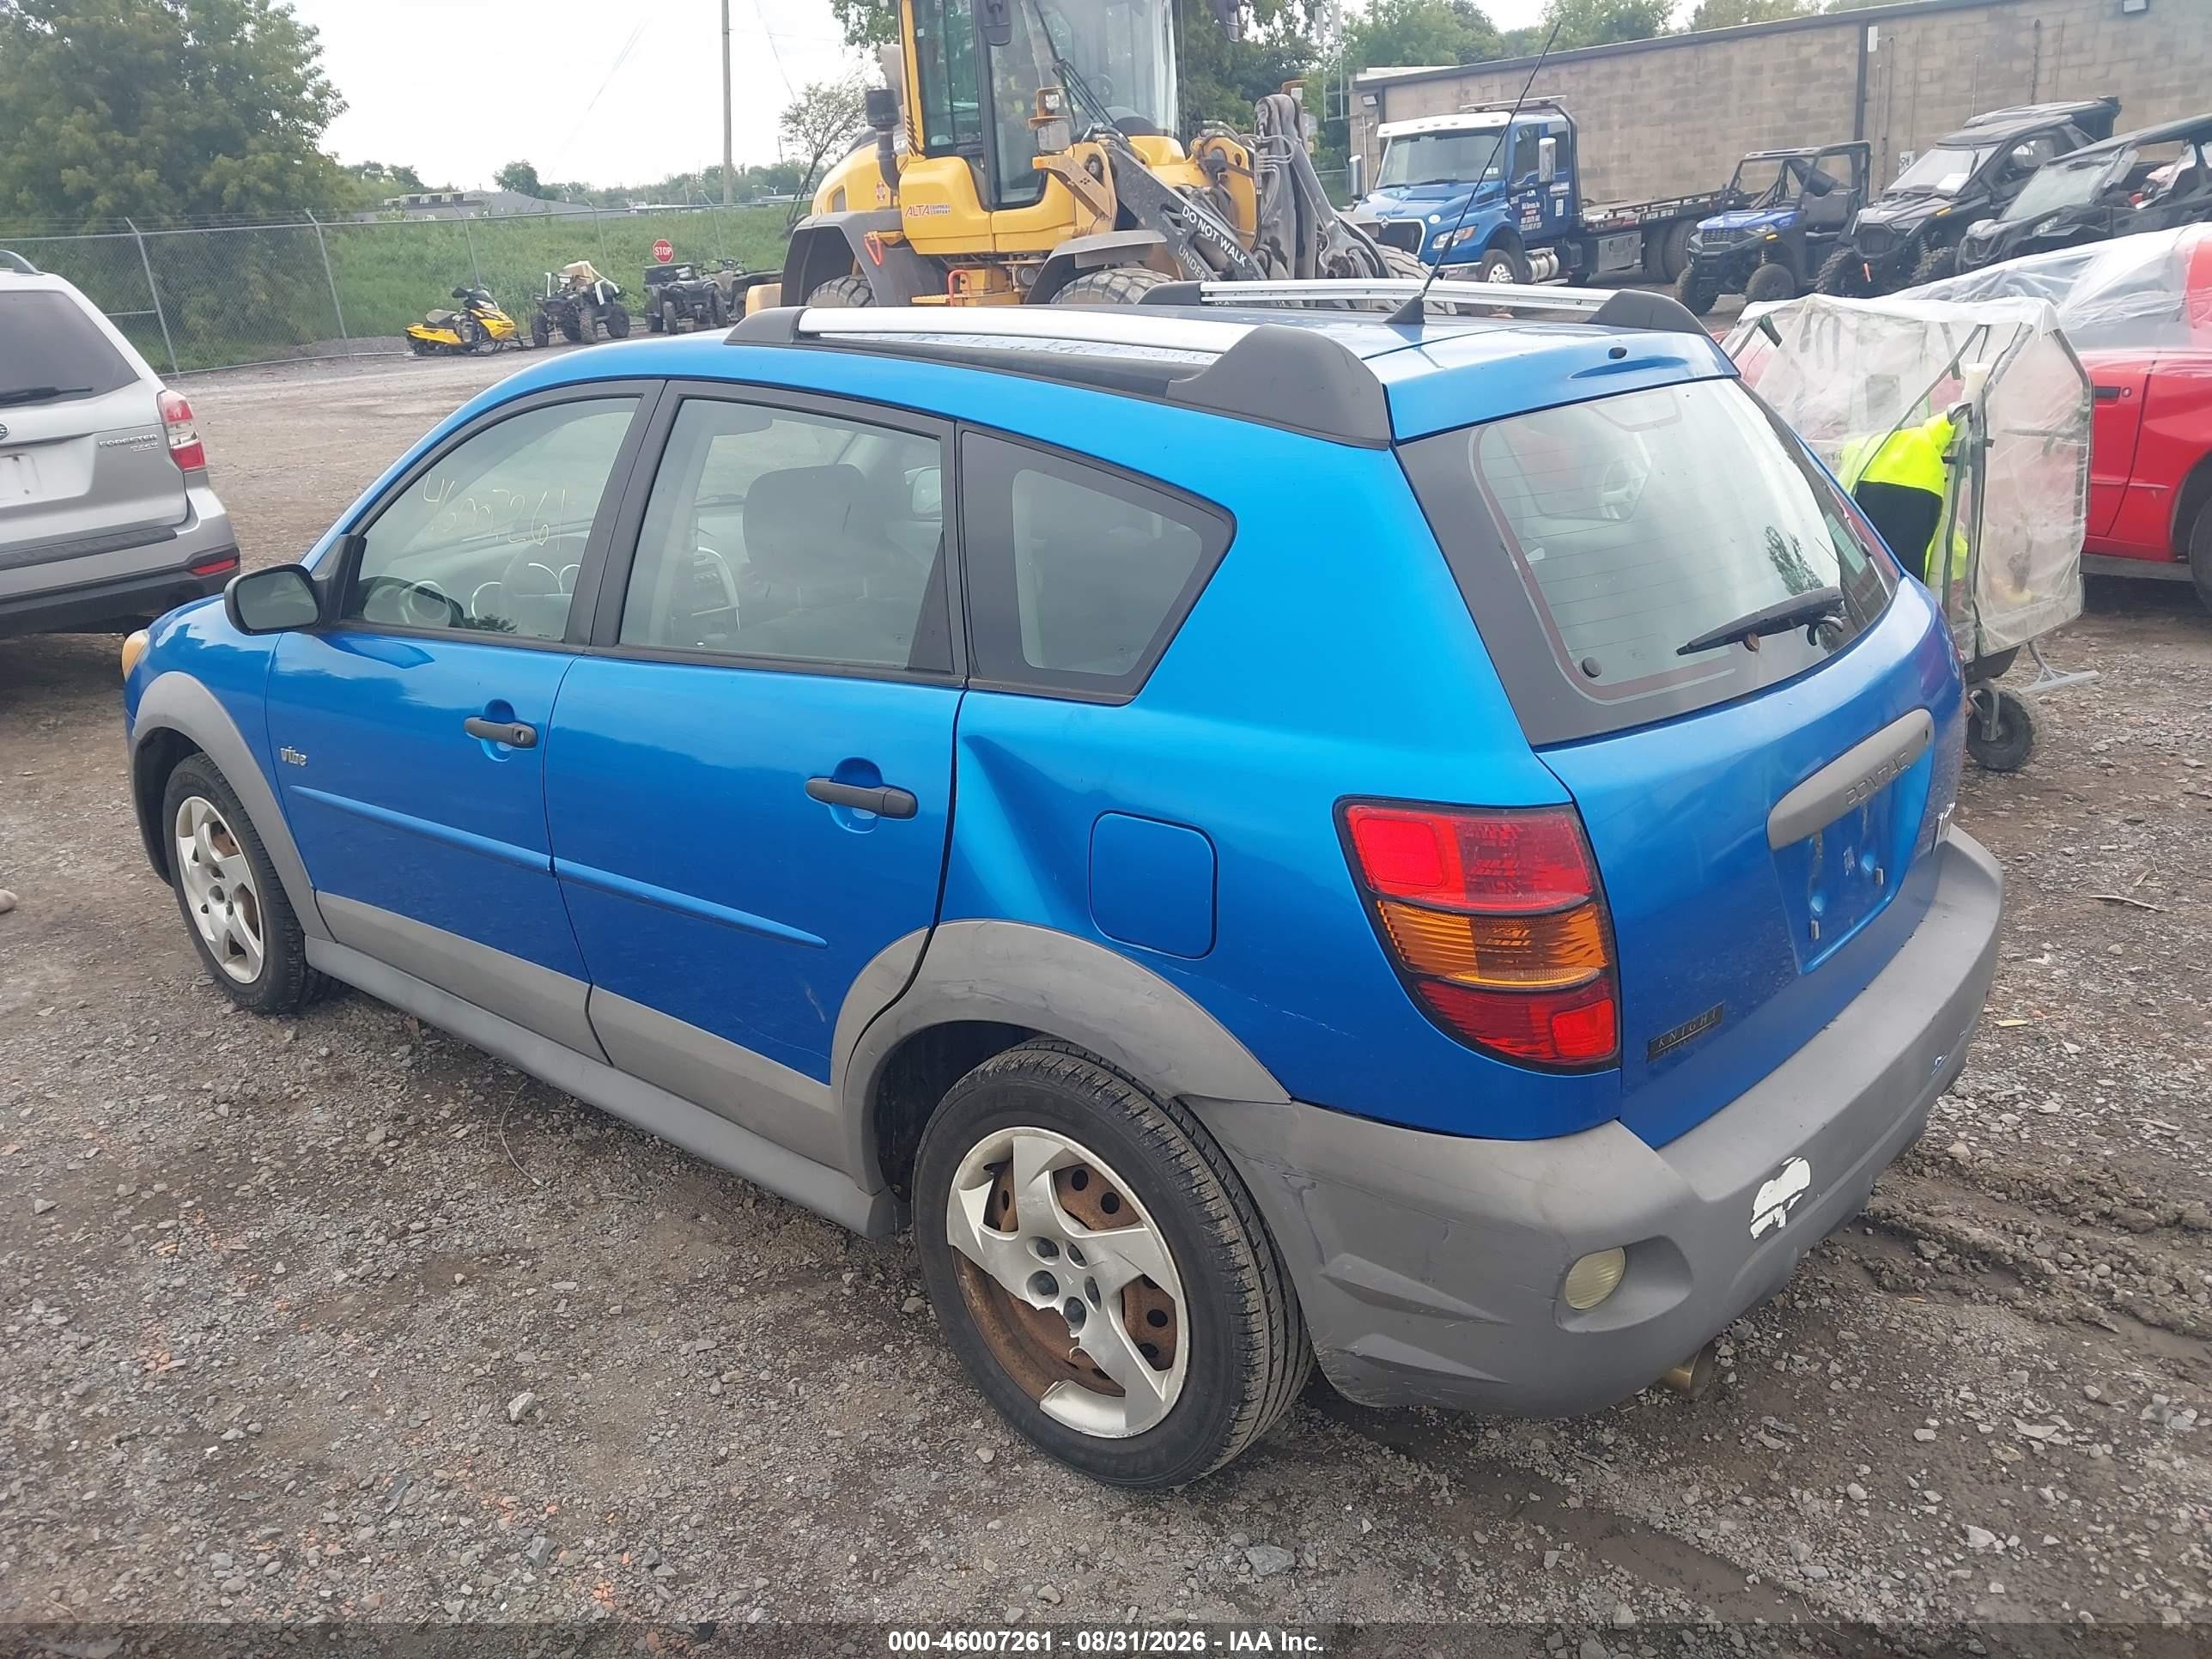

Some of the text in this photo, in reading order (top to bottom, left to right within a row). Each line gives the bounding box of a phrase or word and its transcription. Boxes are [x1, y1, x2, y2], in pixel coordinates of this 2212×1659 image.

[905, 205, 930, 217] ALTA
[1182, 205, 1247, 268] DO NOT WALK
[654, 246, 672, 256] STOP
[1178, 244, 1206, 280] UNDER
